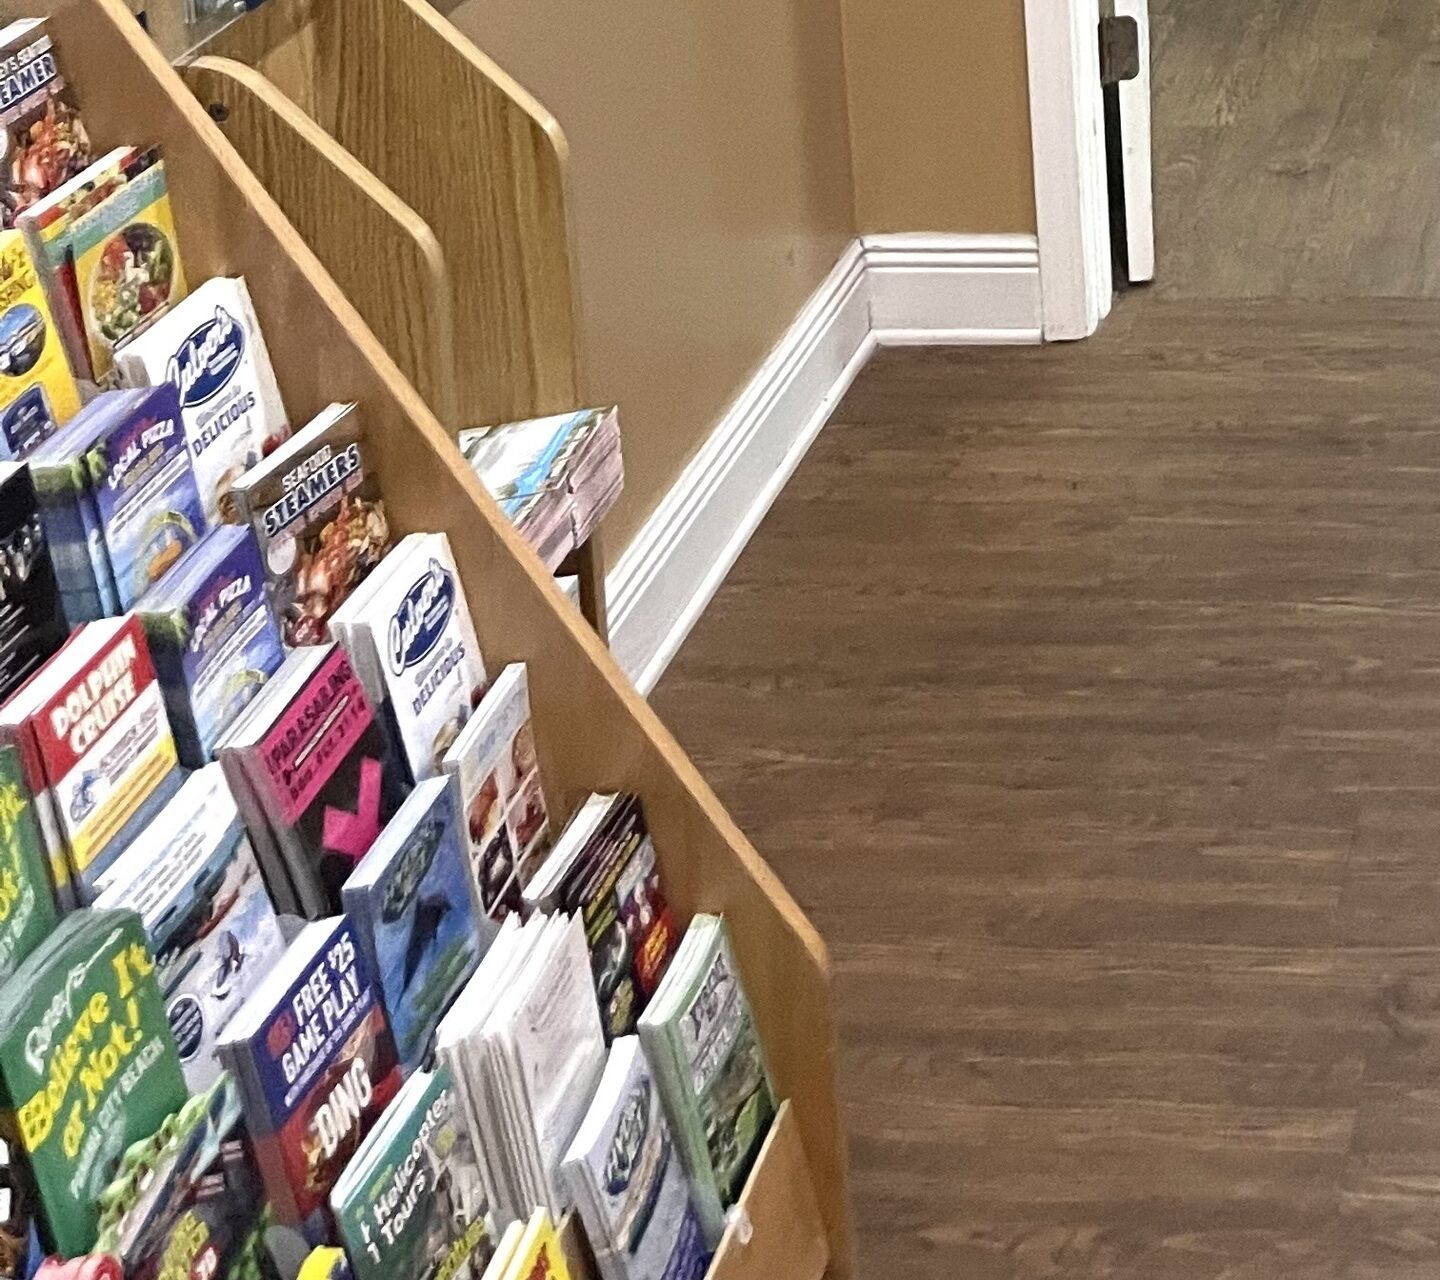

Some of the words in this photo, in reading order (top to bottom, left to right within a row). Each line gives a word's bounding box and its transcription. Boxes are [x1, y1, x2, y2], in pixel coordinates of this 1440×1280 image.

[192, 391, 255, 458] DELICIOUS
[264, 444, 362, 535] STEAMERS
[51, 633, 137, 739] DOLPHIN
[70, 671, 137, 754] CRUISE
[412, 641, 466, 717] DELICIOUS
[282, 1014, 326, 1085] GAME
[323, 966, 361, 1038] PLAY
[293, 961, 331, 1027] FREE
[327, 931, 356, 972] $25
[18, 991, 109, 1153] Believe
[112, 943, 155, 998] It
[63, 1099, 85, 1160] or
[80, 996, 143, 1111] Not!
[381, 1169, 426, 1245] Tours
